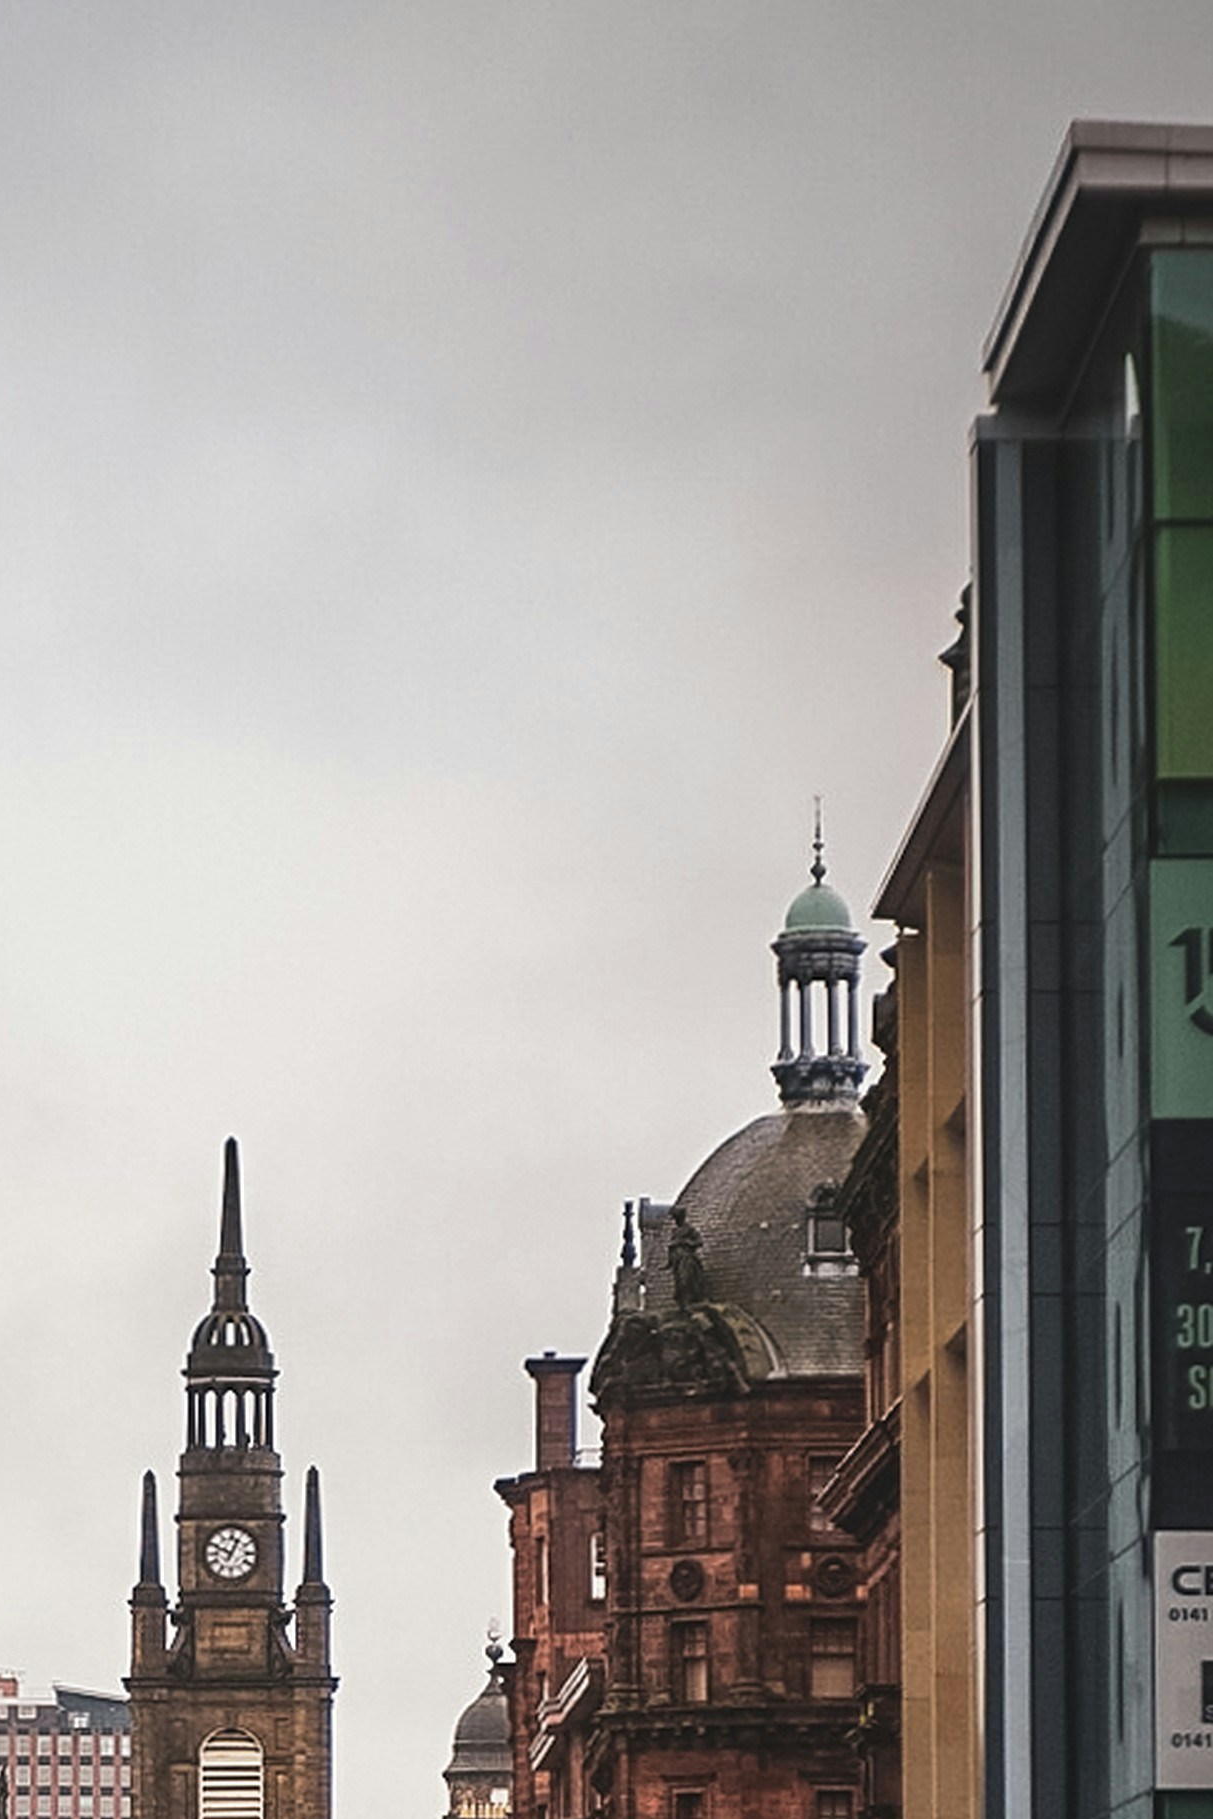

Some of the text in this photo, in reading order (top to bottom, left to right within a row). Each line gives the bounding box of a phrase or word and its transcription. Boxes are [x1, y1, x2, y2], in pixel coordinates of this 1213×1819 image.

[1189, 1365, 1213, 1409] S
[1169, 1607, 1208, 1622] 0141
[1171, 1733, 1212, 1748] 0141
